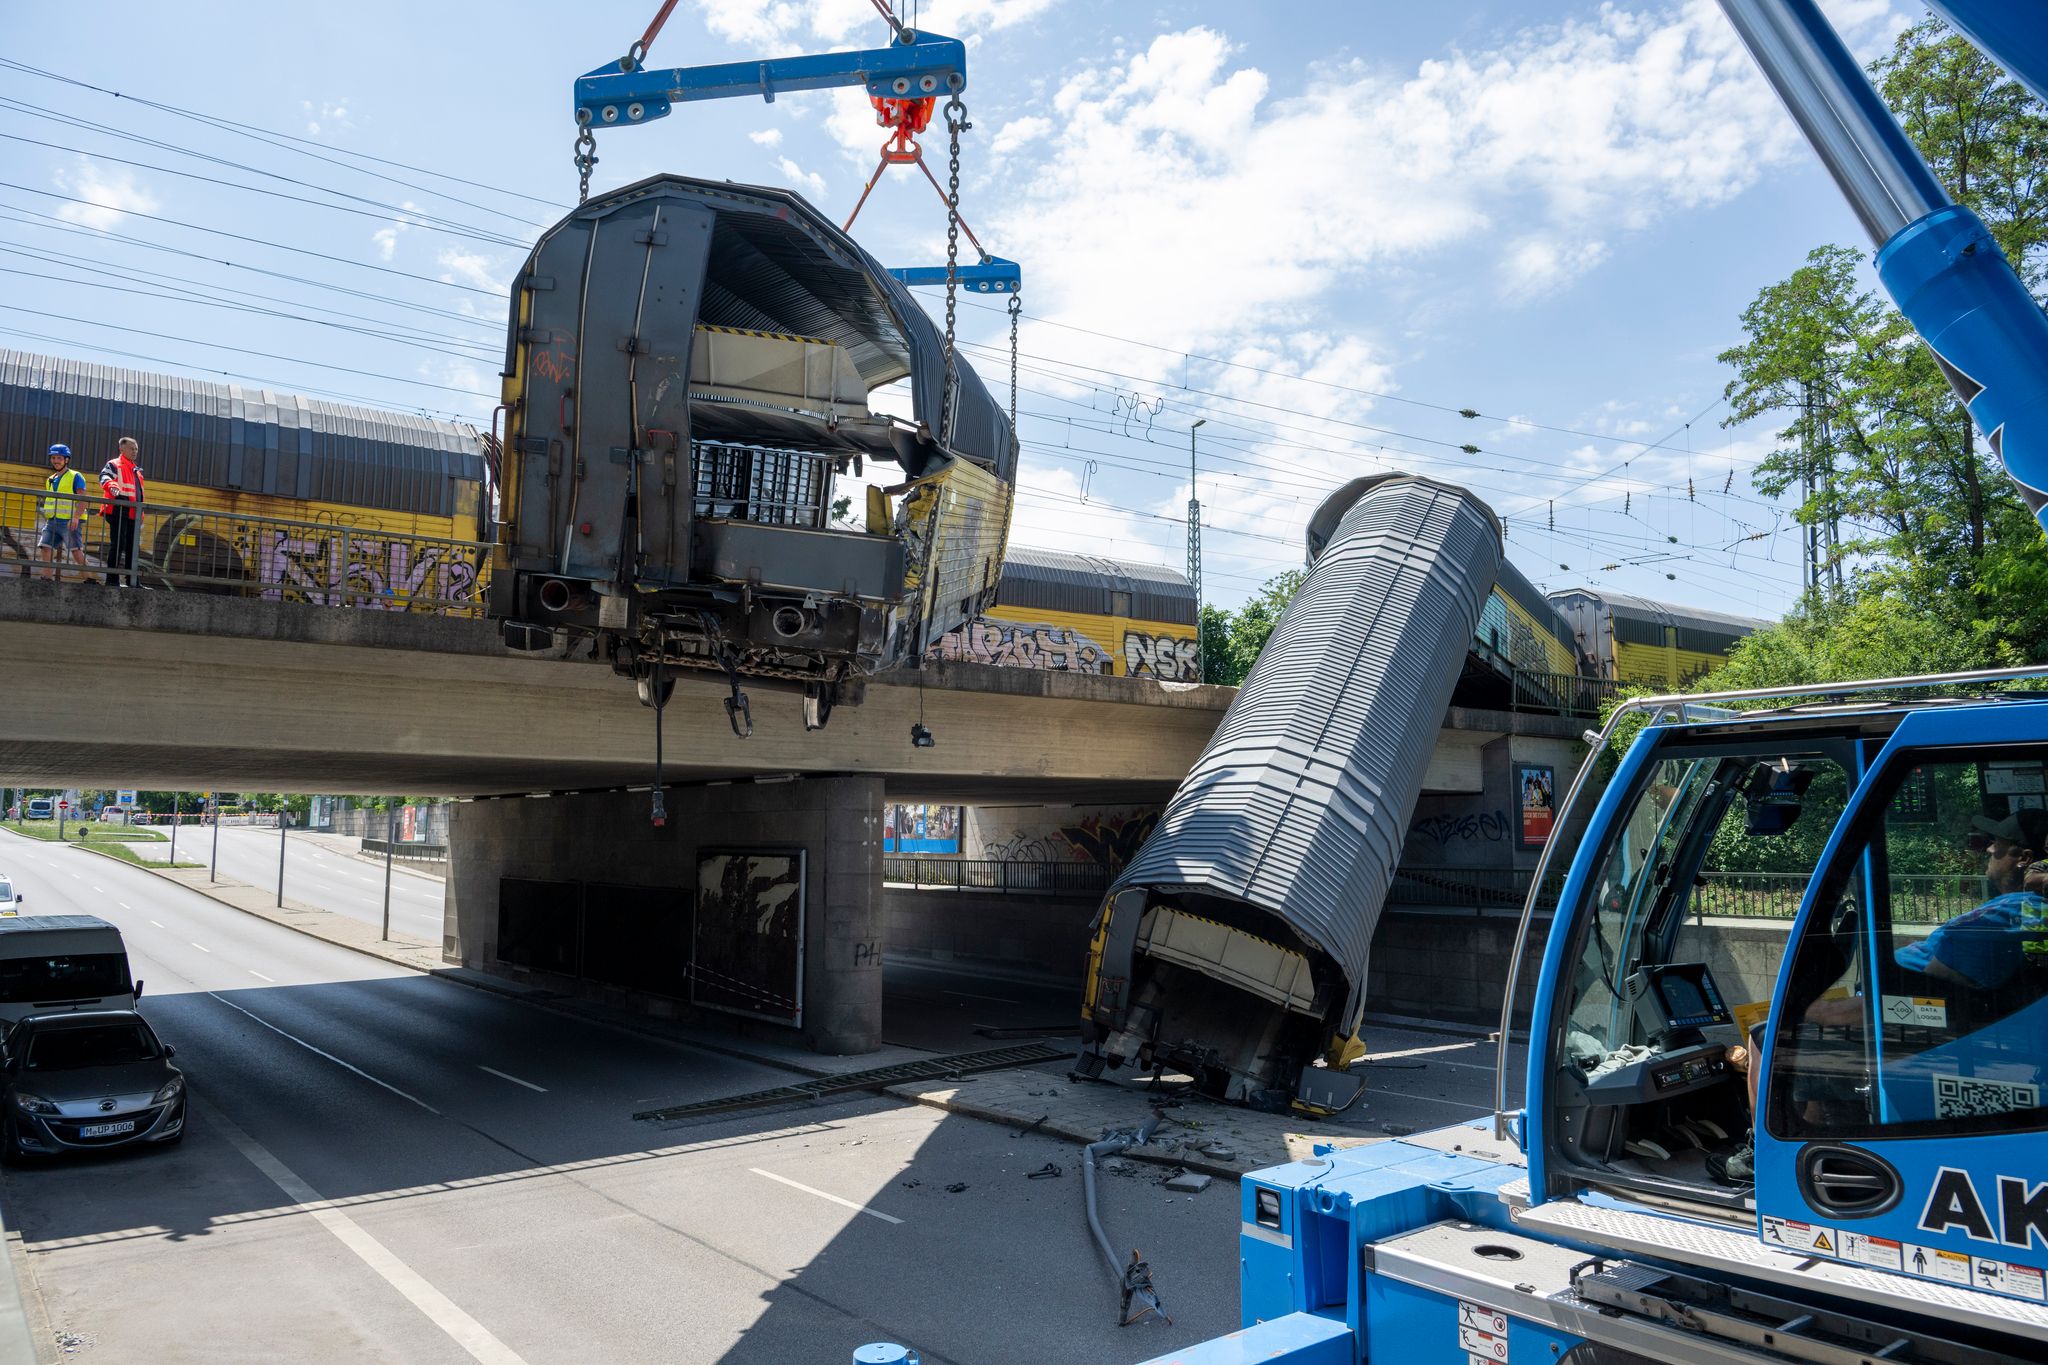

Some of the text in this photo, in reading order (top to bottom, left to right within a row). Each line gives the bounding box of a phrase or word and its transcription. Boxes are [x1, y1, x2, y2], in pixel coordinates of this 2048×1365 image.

[85, 1122, 133, 1136] M UP 1006
